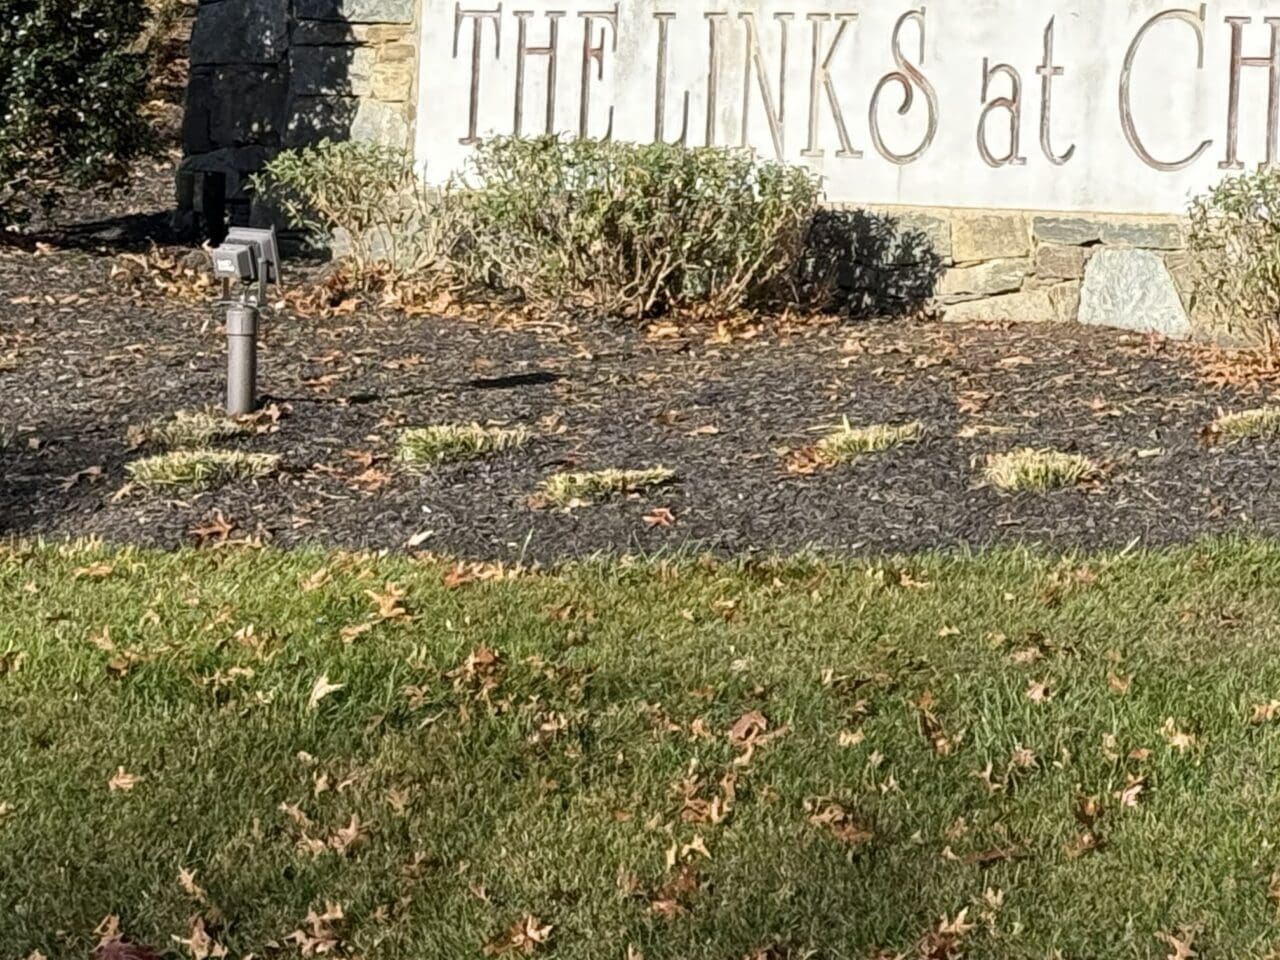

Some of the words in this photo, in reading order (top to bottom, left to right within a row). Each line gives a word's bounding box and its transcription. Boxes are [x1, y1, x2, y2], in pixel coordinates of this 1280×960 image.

[451, 0, 619, 146] THE
[652, 6, 939, 166] LINKS
[975, 14, 1076, 168] at
